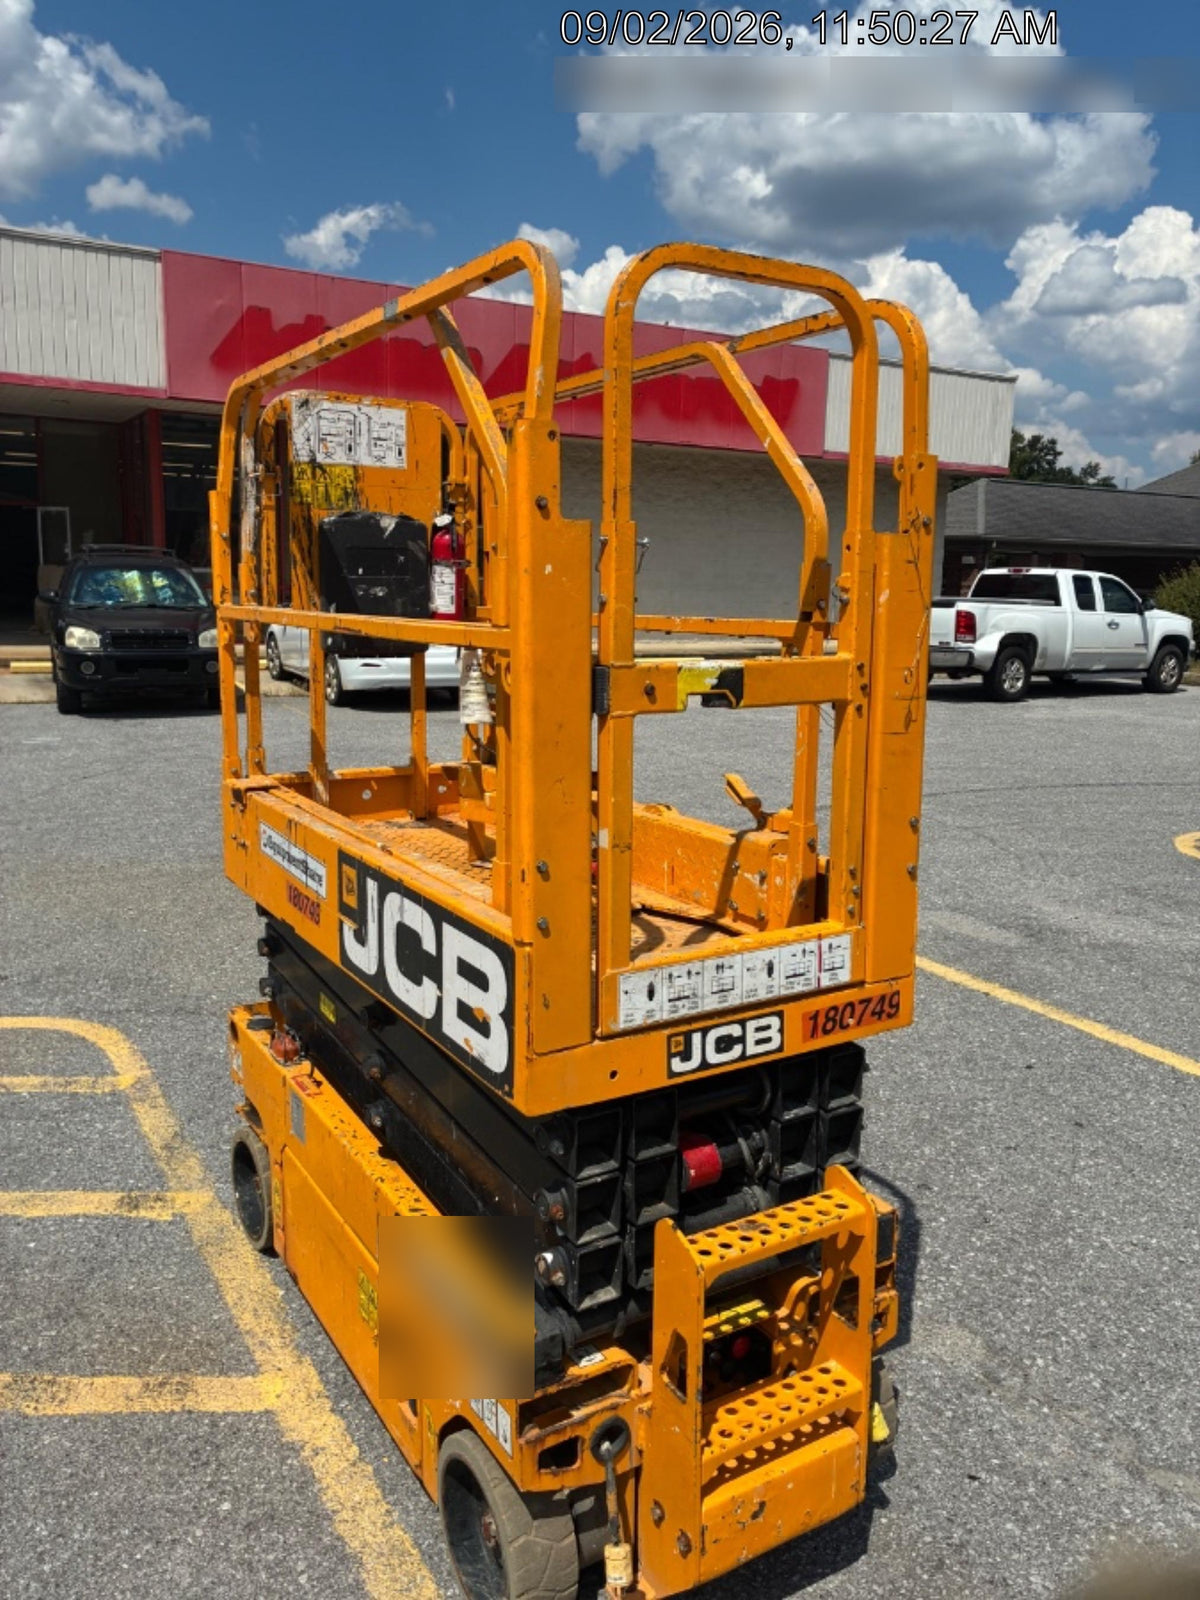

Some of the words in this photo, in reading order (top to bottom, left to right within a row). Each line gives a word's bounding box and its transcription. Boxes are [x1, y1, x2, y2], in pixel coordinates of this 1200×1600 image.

[342, 876, 509, 1074] JCB
[670, 1014, 782, 1074] JCB
[807, 989, 901, 1039] 180749
